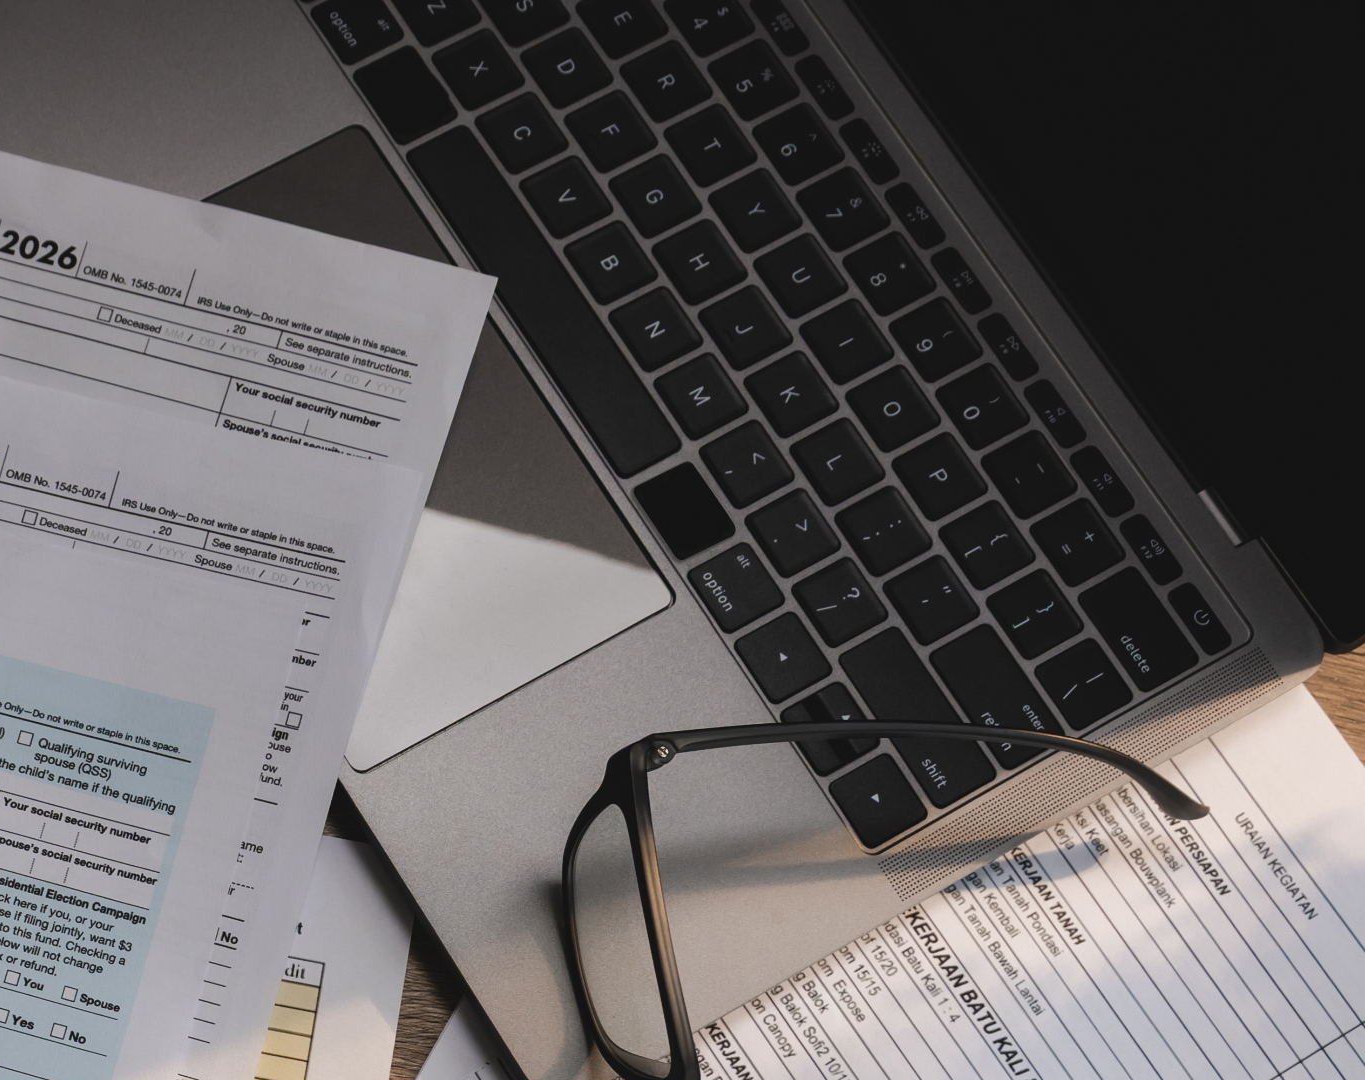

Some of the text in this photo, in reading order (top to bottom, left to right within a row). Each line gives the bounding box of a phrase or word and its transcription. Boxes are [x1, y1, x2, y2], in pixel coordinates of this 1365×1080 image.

[513, 125, 532, 141] C
[558, 188, 577, 203] V
[645, 189, 664, 205] G
[600, 254, 619, 271] B
[689, 253, 710, 271] H
[82, 265, 182, 299] OMB No. 1545-0074
[791, 267, 811, 284] U
[644, 320, 666, 339] N
[284, 337, 412, 379] See separate instructions.
[688, 385, 711, 407] M
[779, 386, 800, 404] K
[928, 468, 948, 482] P
[736, 554, 751, 569] alt
[702, 572, 733, 612] option
[1120, 635, 1150, 674] delete
[1022, 704, 1045, 732] enter
[33, 752, 112, 782] spouse (QSS)
[38, 737, 148, 777] Qualifying surviving
[921, 758, 947, 789] shift
[1235, 812, 1319, 920] URAIAN KEGIATAN
[45, 888, 90, 910] Election
[91, 901, 147, 925] Campaign
